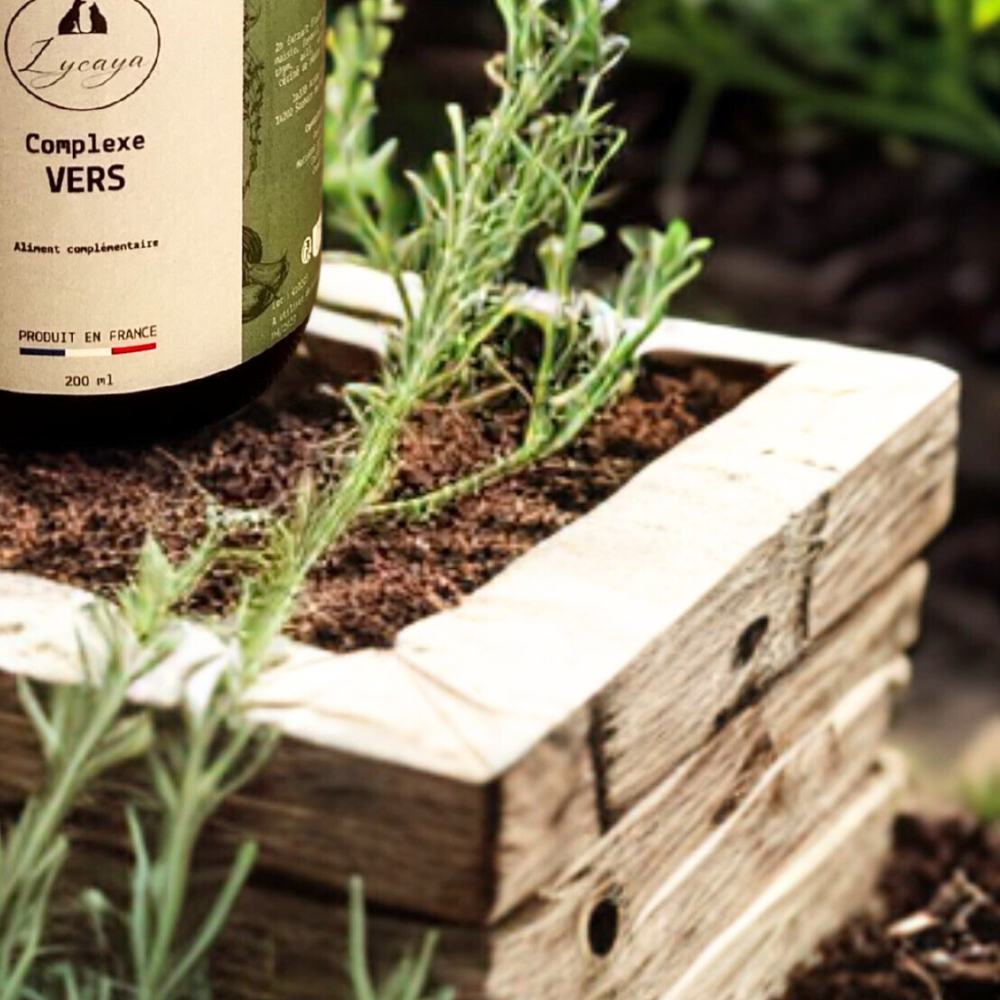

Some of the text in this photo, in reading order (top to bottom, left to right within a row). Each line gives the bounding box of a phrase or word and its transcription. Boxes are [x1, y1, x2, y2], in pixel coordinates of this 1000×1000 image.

[18, 37, 145, 89] Lycaya
[25, 132, 146, 159] Complexe
[46, 164, 126, 194] VERS
[13, 239, 159, 256] Aliment complémentaire
[18, 324, 158, 344] PRODUIT EN FRANCE
[65, 373, 114, 387] 200 ml
